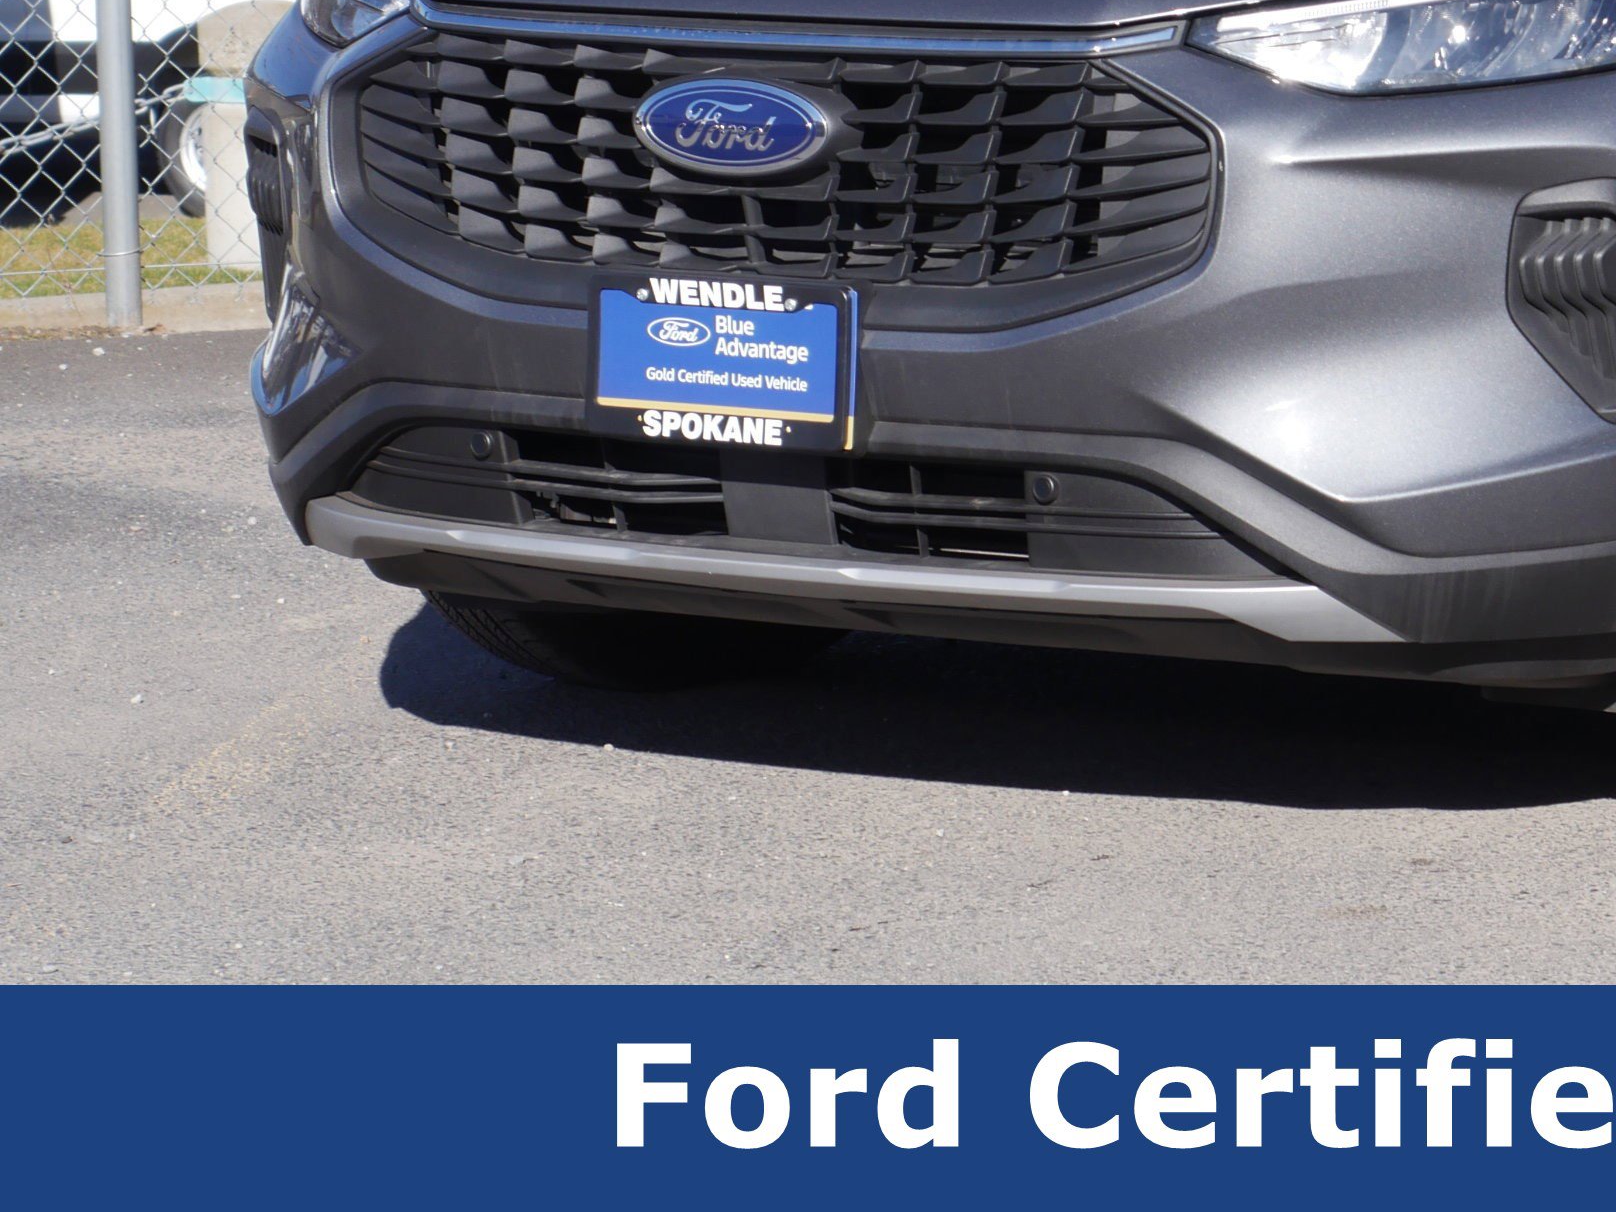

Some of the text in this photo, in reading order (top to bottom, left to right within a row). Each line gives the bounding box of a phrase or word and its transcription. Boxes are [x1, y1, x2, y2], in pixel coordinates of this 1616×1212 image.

[674, 98, 775, 152] Ford
[649, 277, 785, 312] WENDLE
[658, 315, 755, 342] Ford Blue
[714, 336, 809, 365] Advantage
[645, 366, 808, 392] Gold Certified Used Vehicle
[642, 409, 783, 446] SPOKANE
